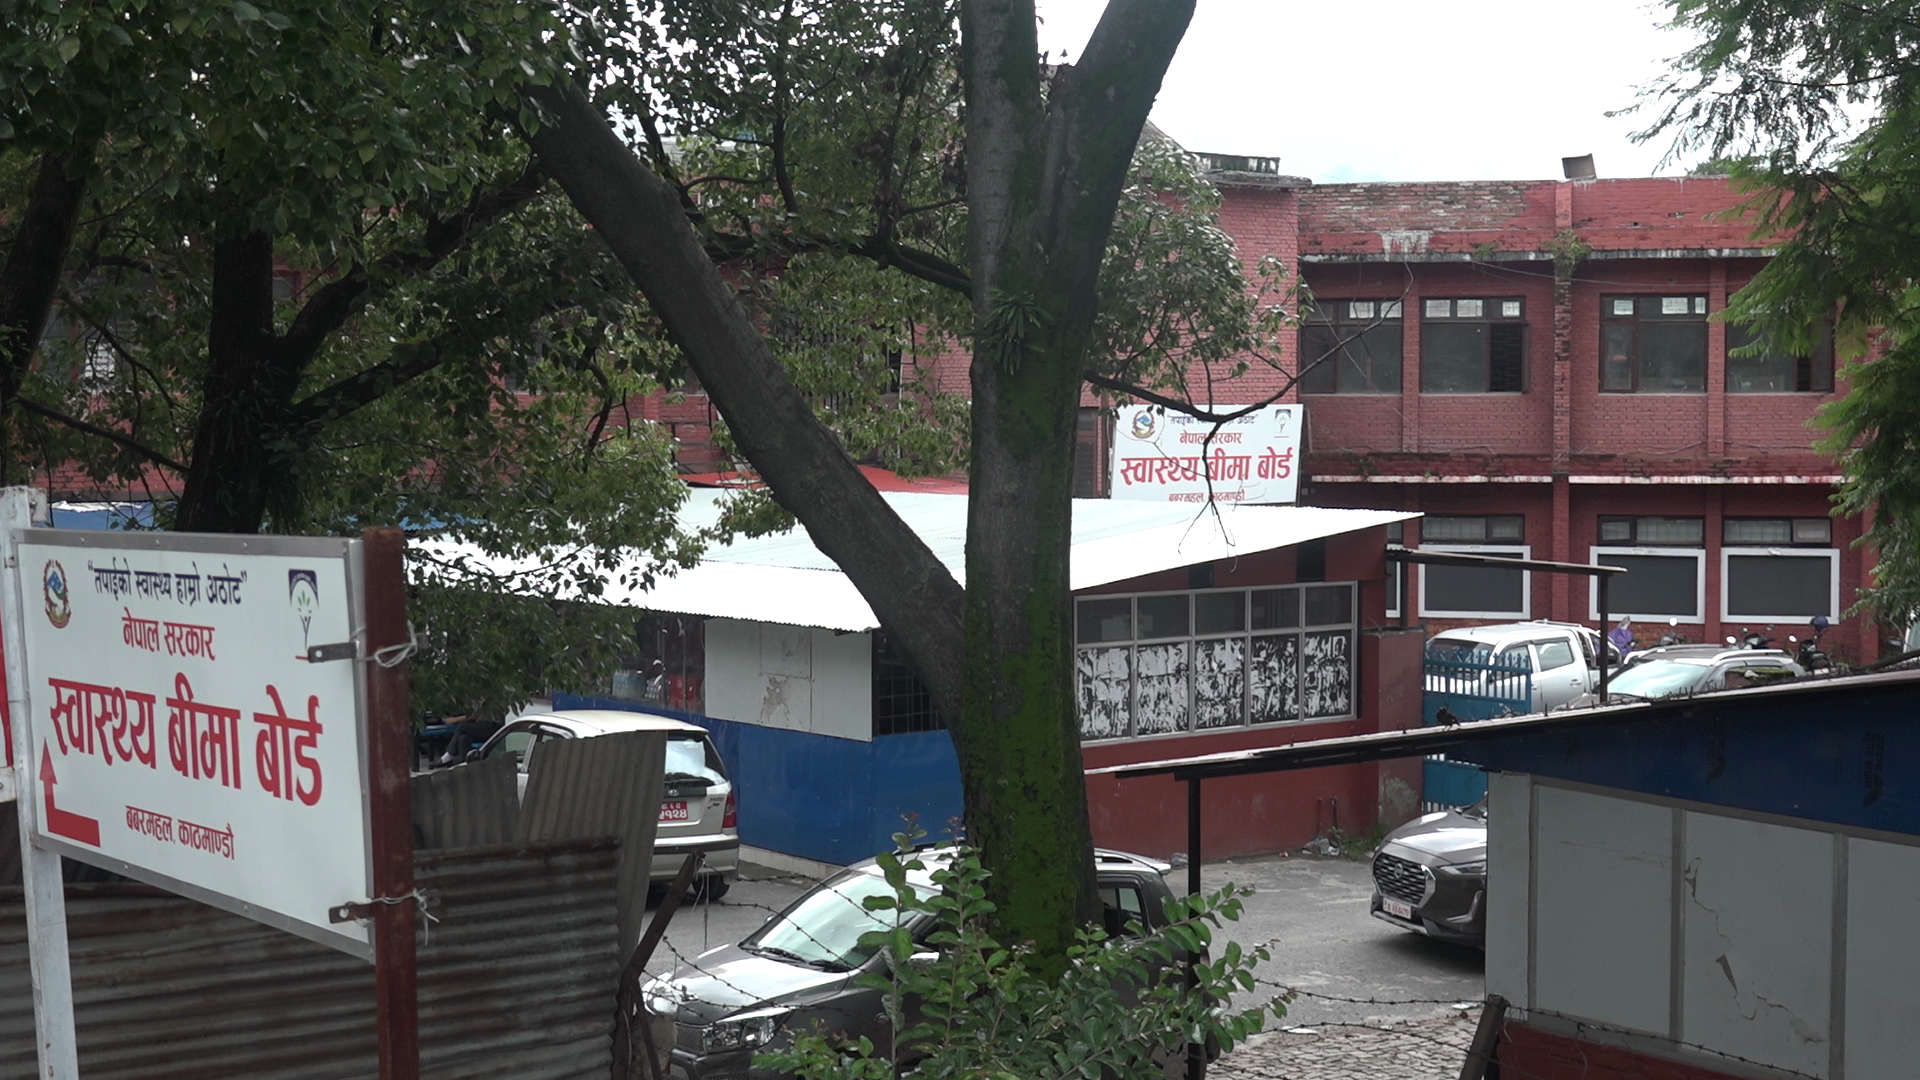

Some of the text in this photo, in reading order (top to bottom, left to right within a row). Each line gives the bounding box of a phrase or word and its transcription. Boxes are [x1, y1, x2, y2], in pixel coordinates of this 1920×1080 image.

[1180, 429, 1207, 444] नेपाल
[1120, 446, 1293, 486] स्वास्थ्य बीमा बोर्ड
[134, 570, 173, 601] स्वास्थ्य
[174, 561, 201, 607] हाम्रो
[122, 606, 216, 661] नेपाल सरकार
[48, 671, 324, 807] स्वास्थ्य बीमा बोर्ड
